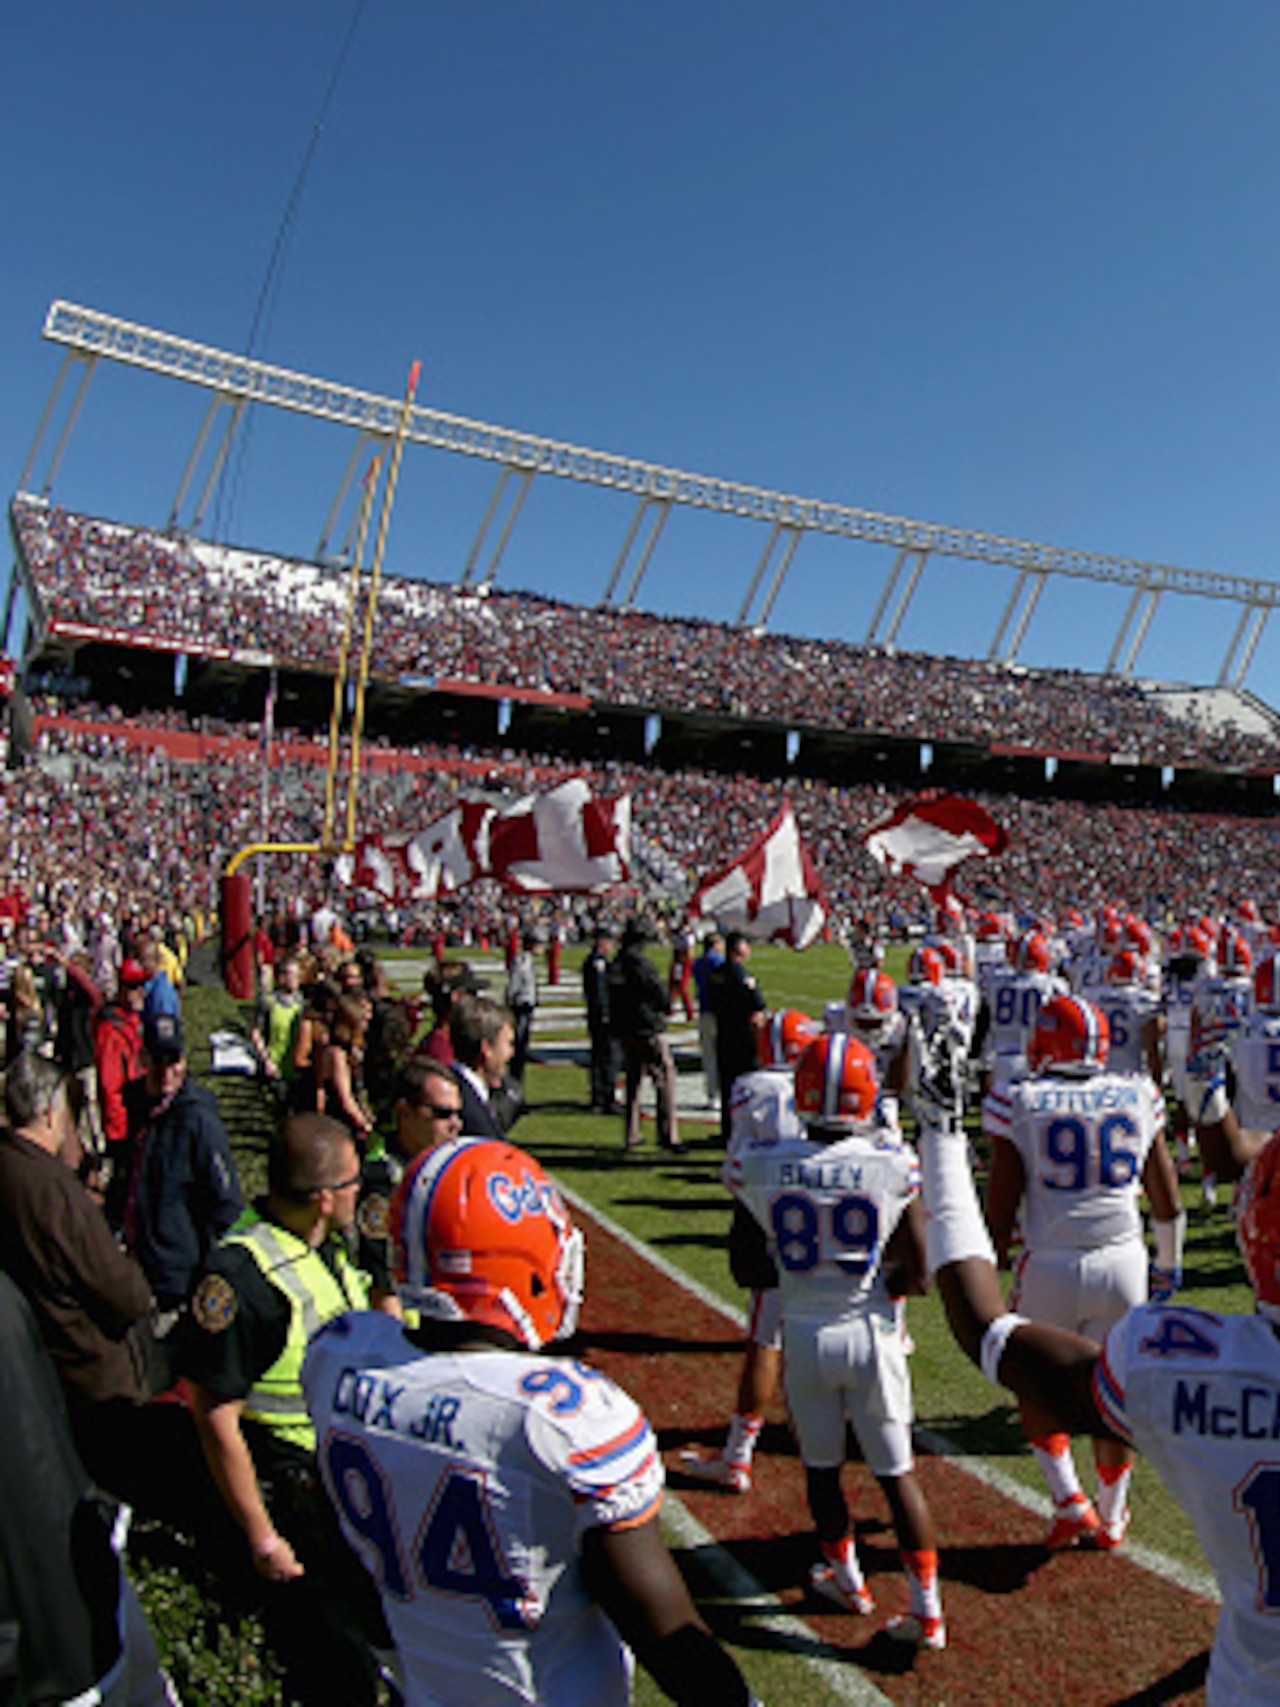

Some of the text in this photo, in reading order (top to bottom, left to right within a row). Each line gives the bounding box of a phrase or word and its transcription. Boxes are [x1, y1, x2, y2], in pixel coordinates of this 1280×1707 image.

[996, 987, 1042, 1026] 80
[1040, 1111, 1140, 1192] 96
[769, 1190, 882, 1275] 89
[332, 1367, 406, 1431] COX
[317, 1427, 540, 1638] 94
